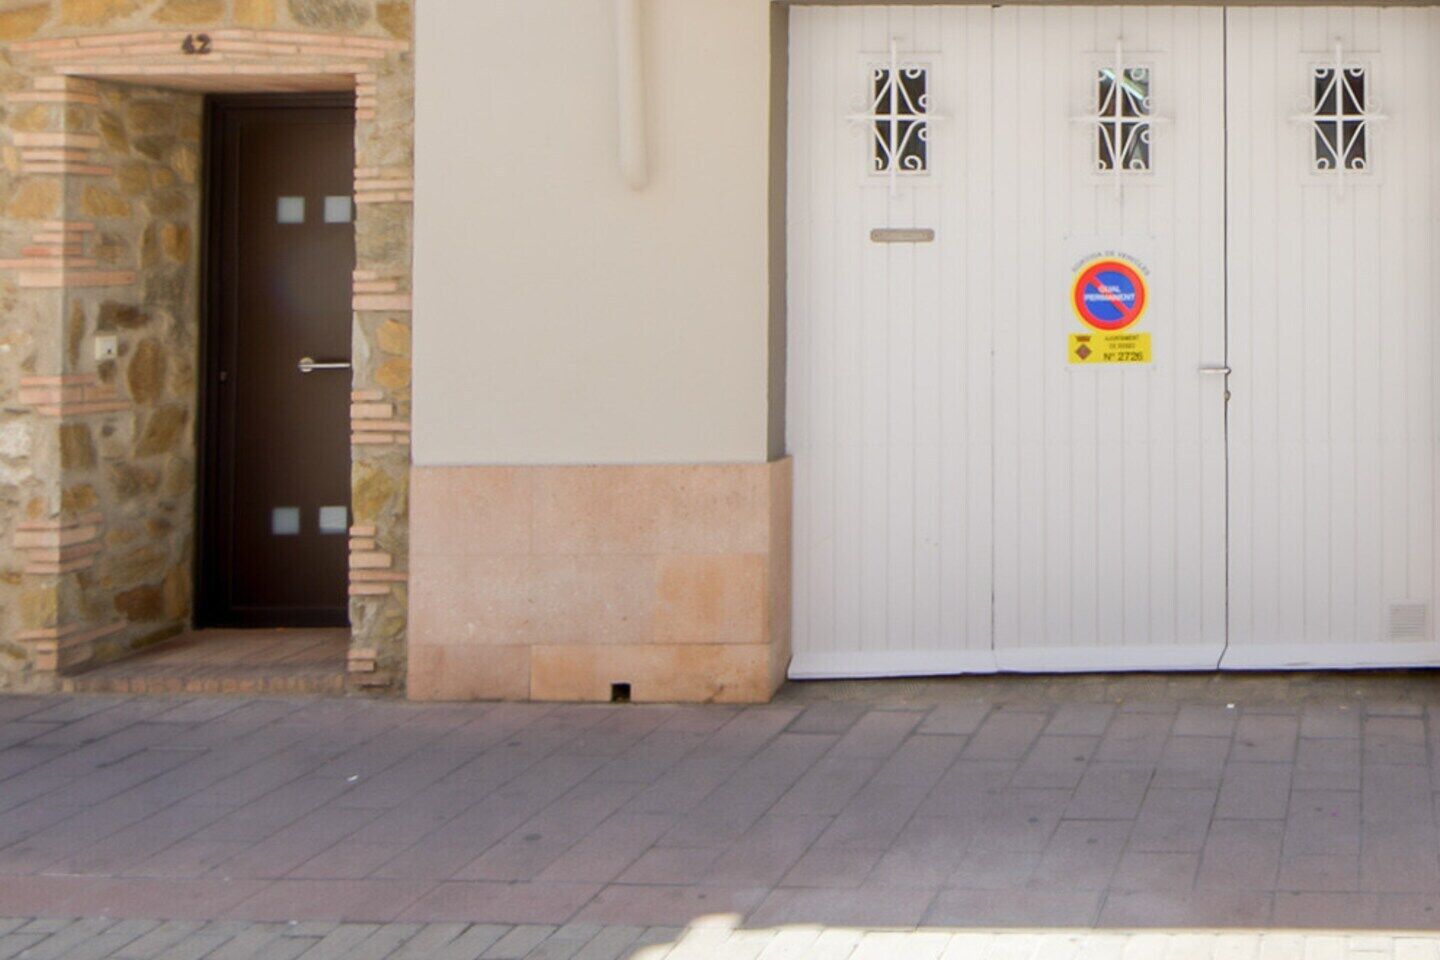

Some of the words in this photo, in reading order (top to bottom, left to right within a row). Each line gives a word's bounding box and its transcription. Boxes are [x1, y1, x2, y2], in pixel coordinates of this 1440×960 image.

[181, 32, 210, 54] 42
[1084, 292, 1136, 302] PERMANENT
[1118, 351, 1144, 360] 2726
